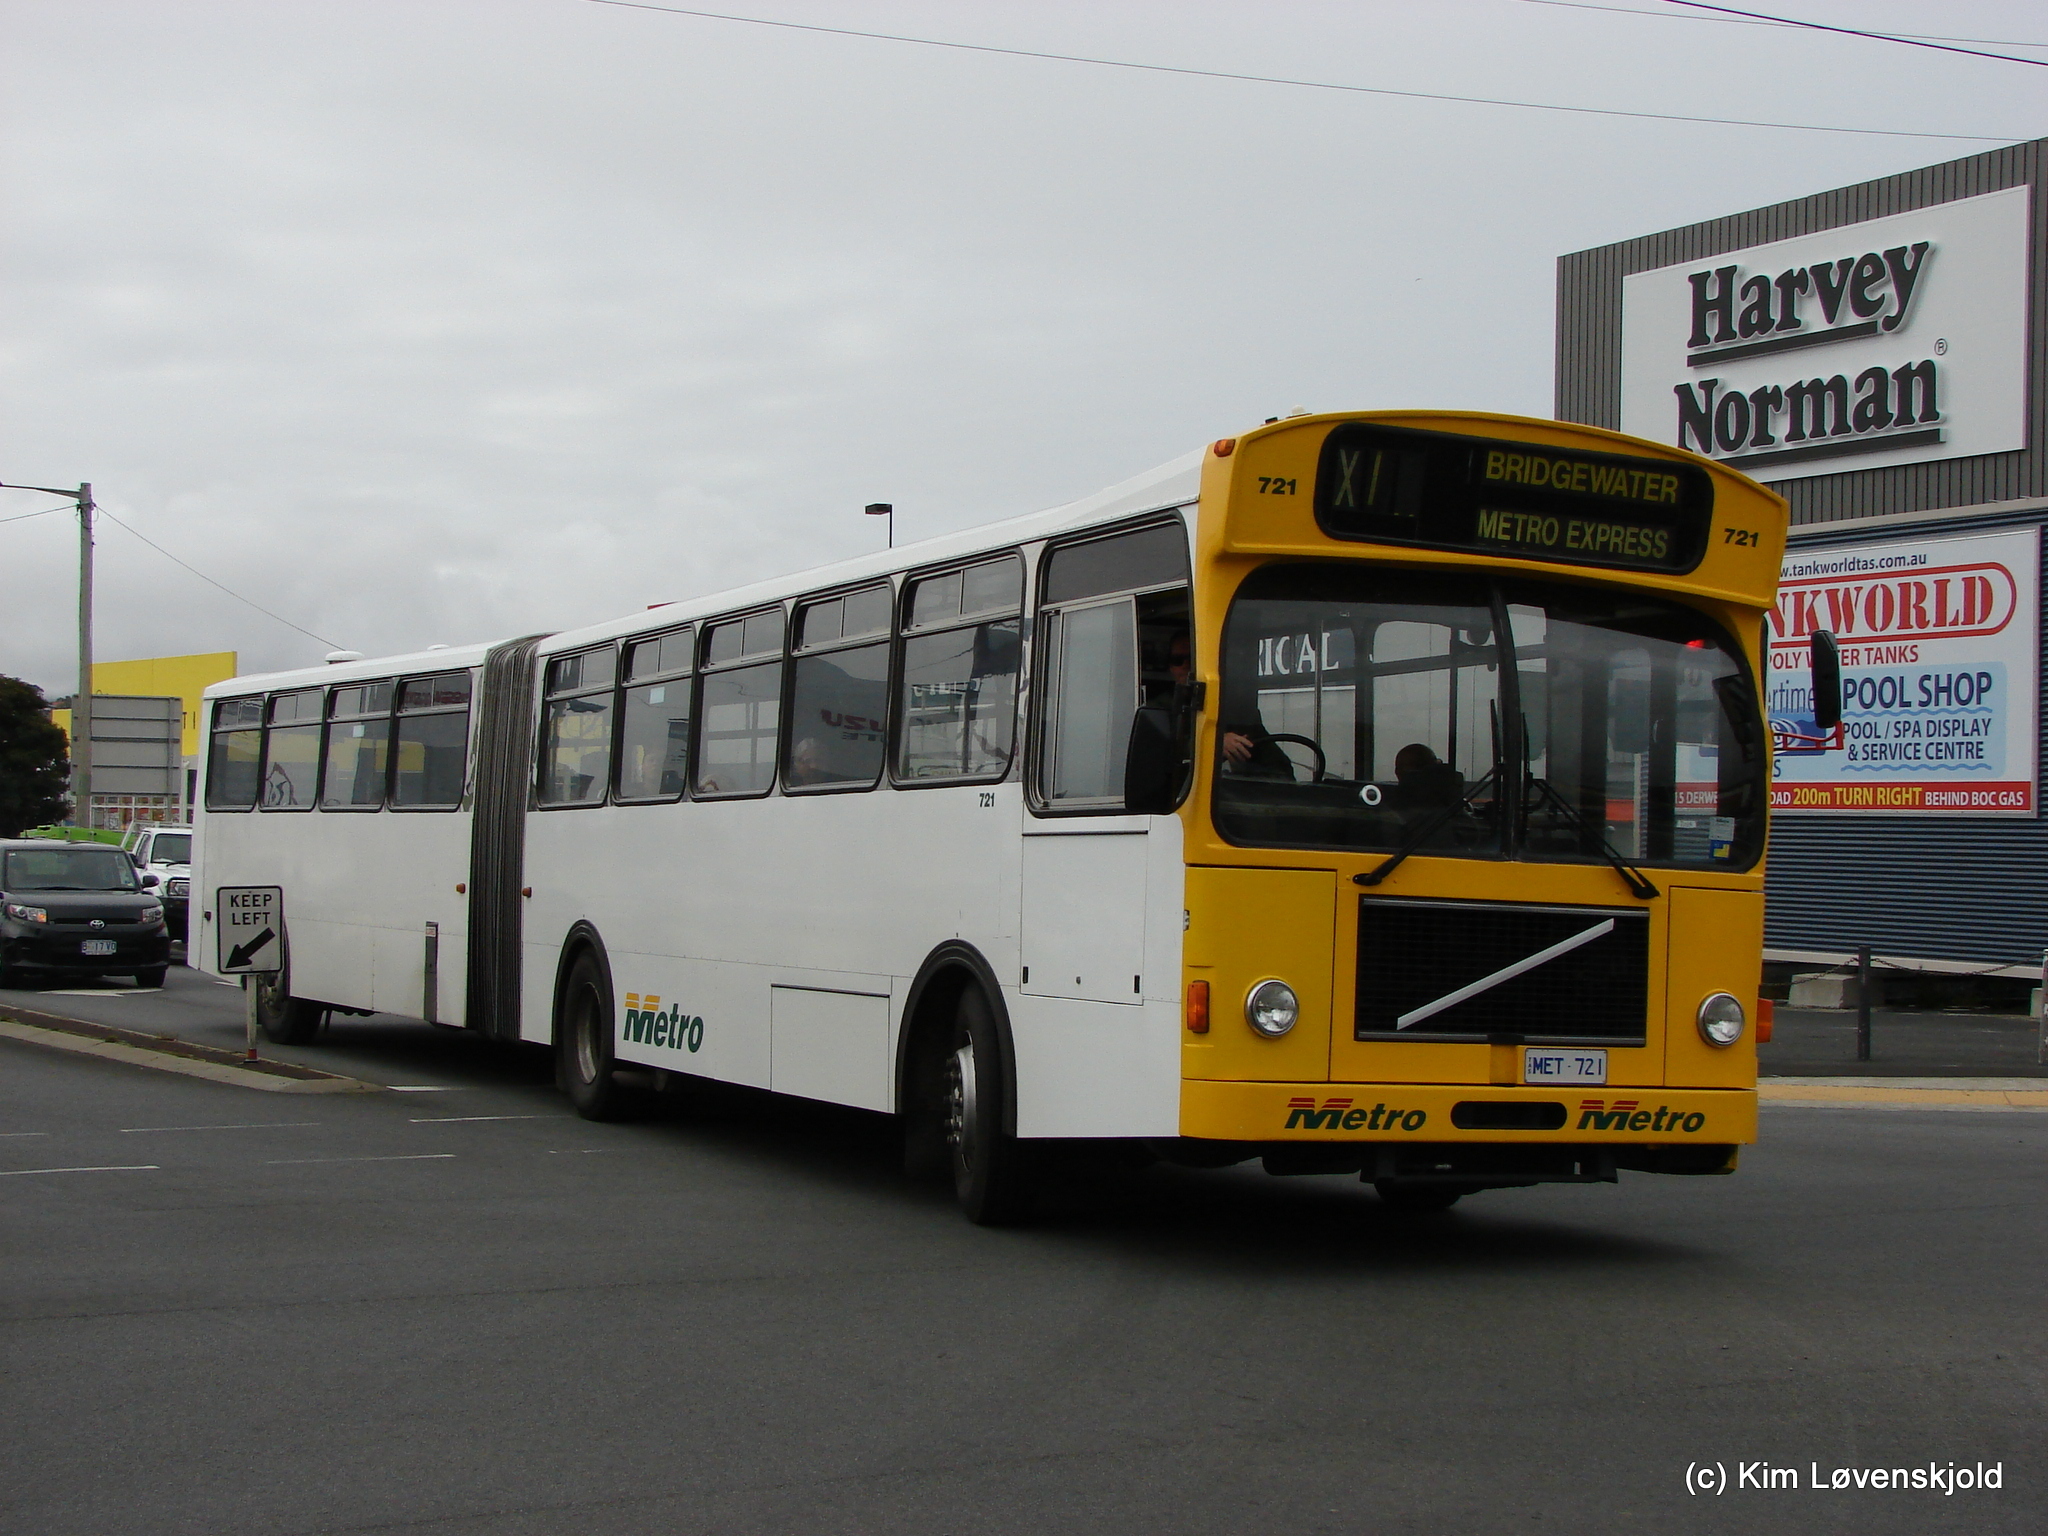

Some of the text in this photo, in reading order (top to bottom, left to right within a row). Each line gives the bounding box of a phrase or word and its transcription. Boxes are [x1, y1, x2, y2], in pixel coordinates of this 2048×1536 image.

[1687, 240, 1931, 348] Harvey
[1673, 358, 1941, 456] Norman
[1257, 477, 1297, 496] 721
[1485, 450, 1679, 504] BRIDGEWATER
[1477, 509, 1669, 559] METRO EXPRESS
[1723, 528, 1759, 548] 721
[1769, 651, 1801, 670] OLY
[1864, 644, 1919, 665] TANKS
[1842, 671, 1993, 710] POOL SHOP
[1843, 720, 1881, 740] POOL
[1893, 719, 1922, 739] SPA
[1926, 718, 1992, 738] DISPLAY
[1847, 741, 1984, 761] & SERVICE CENTRE
[979, 792, 995, 808] 721
[1793, 788, 1831, 805] 200m
[1834, 787, 1876, 805] TURN
[1876, 787, 1923, 805] RIGHT
[1925, 791, 1969, 806] BEHIND
[1971, 791, 1996, 806] BOC
[1998, 791, 2024, 806] GAS
[230, 893, 273, 907] KEEP
[231, 911, 271, 926] LEFT
[623, 992, 705, 1054] Metro
[1532, 1057, 1602, 1076] MET 721
[1284, 1097, 1427, 1131] Metro
[1576, 1100, 1706, 1133] Metro
